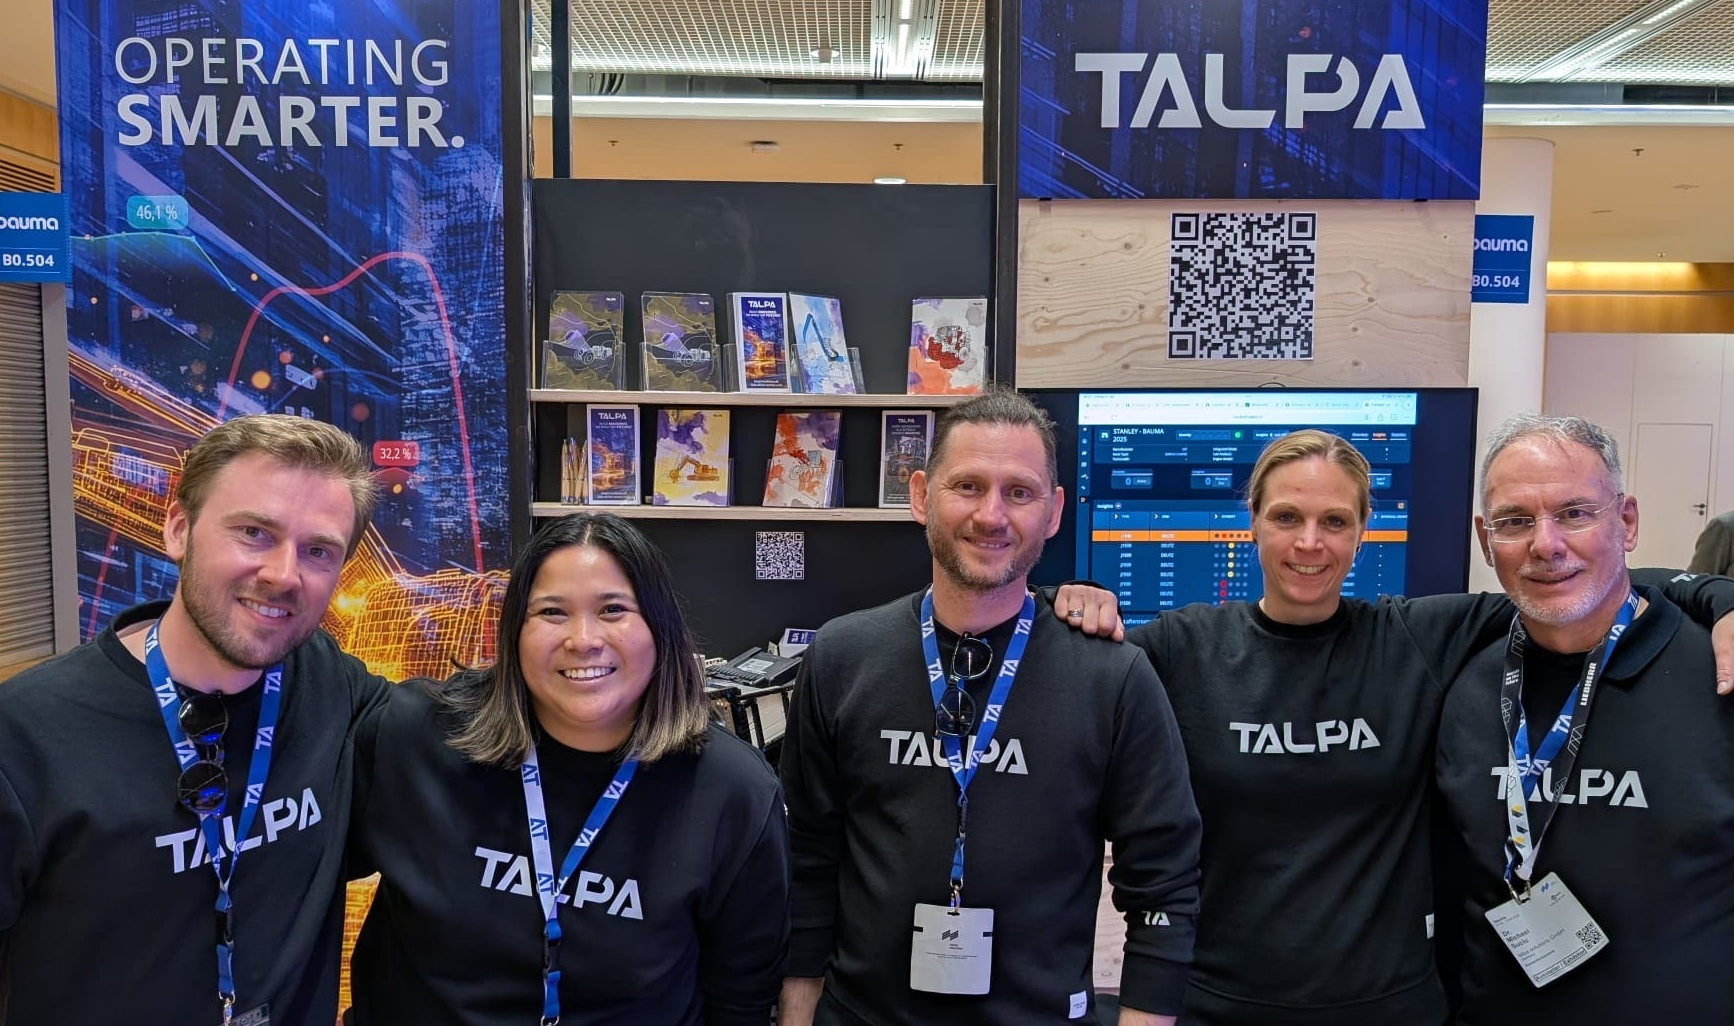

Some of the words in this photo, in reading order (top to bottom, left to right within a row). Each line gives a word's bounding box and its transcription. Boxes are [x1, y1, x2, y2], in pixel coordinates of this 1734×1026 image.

[115, 37, 449, 86] OPERATING
[1075, 53, 1426, 129] TALPA
[117, 94, 465, 148] SMARTER.
[136, 204, 161, 222] 46,1
[166, 205, 178, 220] %
[2, 254, 54, 266] B0.504
[1472, 275, 1520, 288] B0.504
[748, 300, 776, 308] TALPA
[598, 412, 628, 420] TALPA
[380, 448, 400, 460] 32,2
[402, 448, 412, 460] %
[922, 616, 935, 638] TA
[1015, 618, 1032, 635] TA
[928, 658, 943, 682] TA
[999, 660, 1019, 677] TA
[156, 677, 178, 708] TA
[264, 672, 281, 695] TA
[1580, 662, 1596, 706] LIEBHERR
[983, 704, 1003, 723] TA
[1552, 714, 1572, 734] TA
[255, 726, 274, 750] TA
[1230, 718, 1380, 754] TALPA
[175, 739, 197, 764] TA
[970, 750, 984, 768] TA
[948, 750, 964, 774] TA
[1526, 759, 1550, 776] TA
[244, 783, 263, 808] TA
[603, 780, 628, 800] TA
[574, 828, 599, 847] TA
[475, 846, 643, 920] TAPA
[1142, 911, 1170, 926] TA
[1507, 929, 1530, 942] Michael
